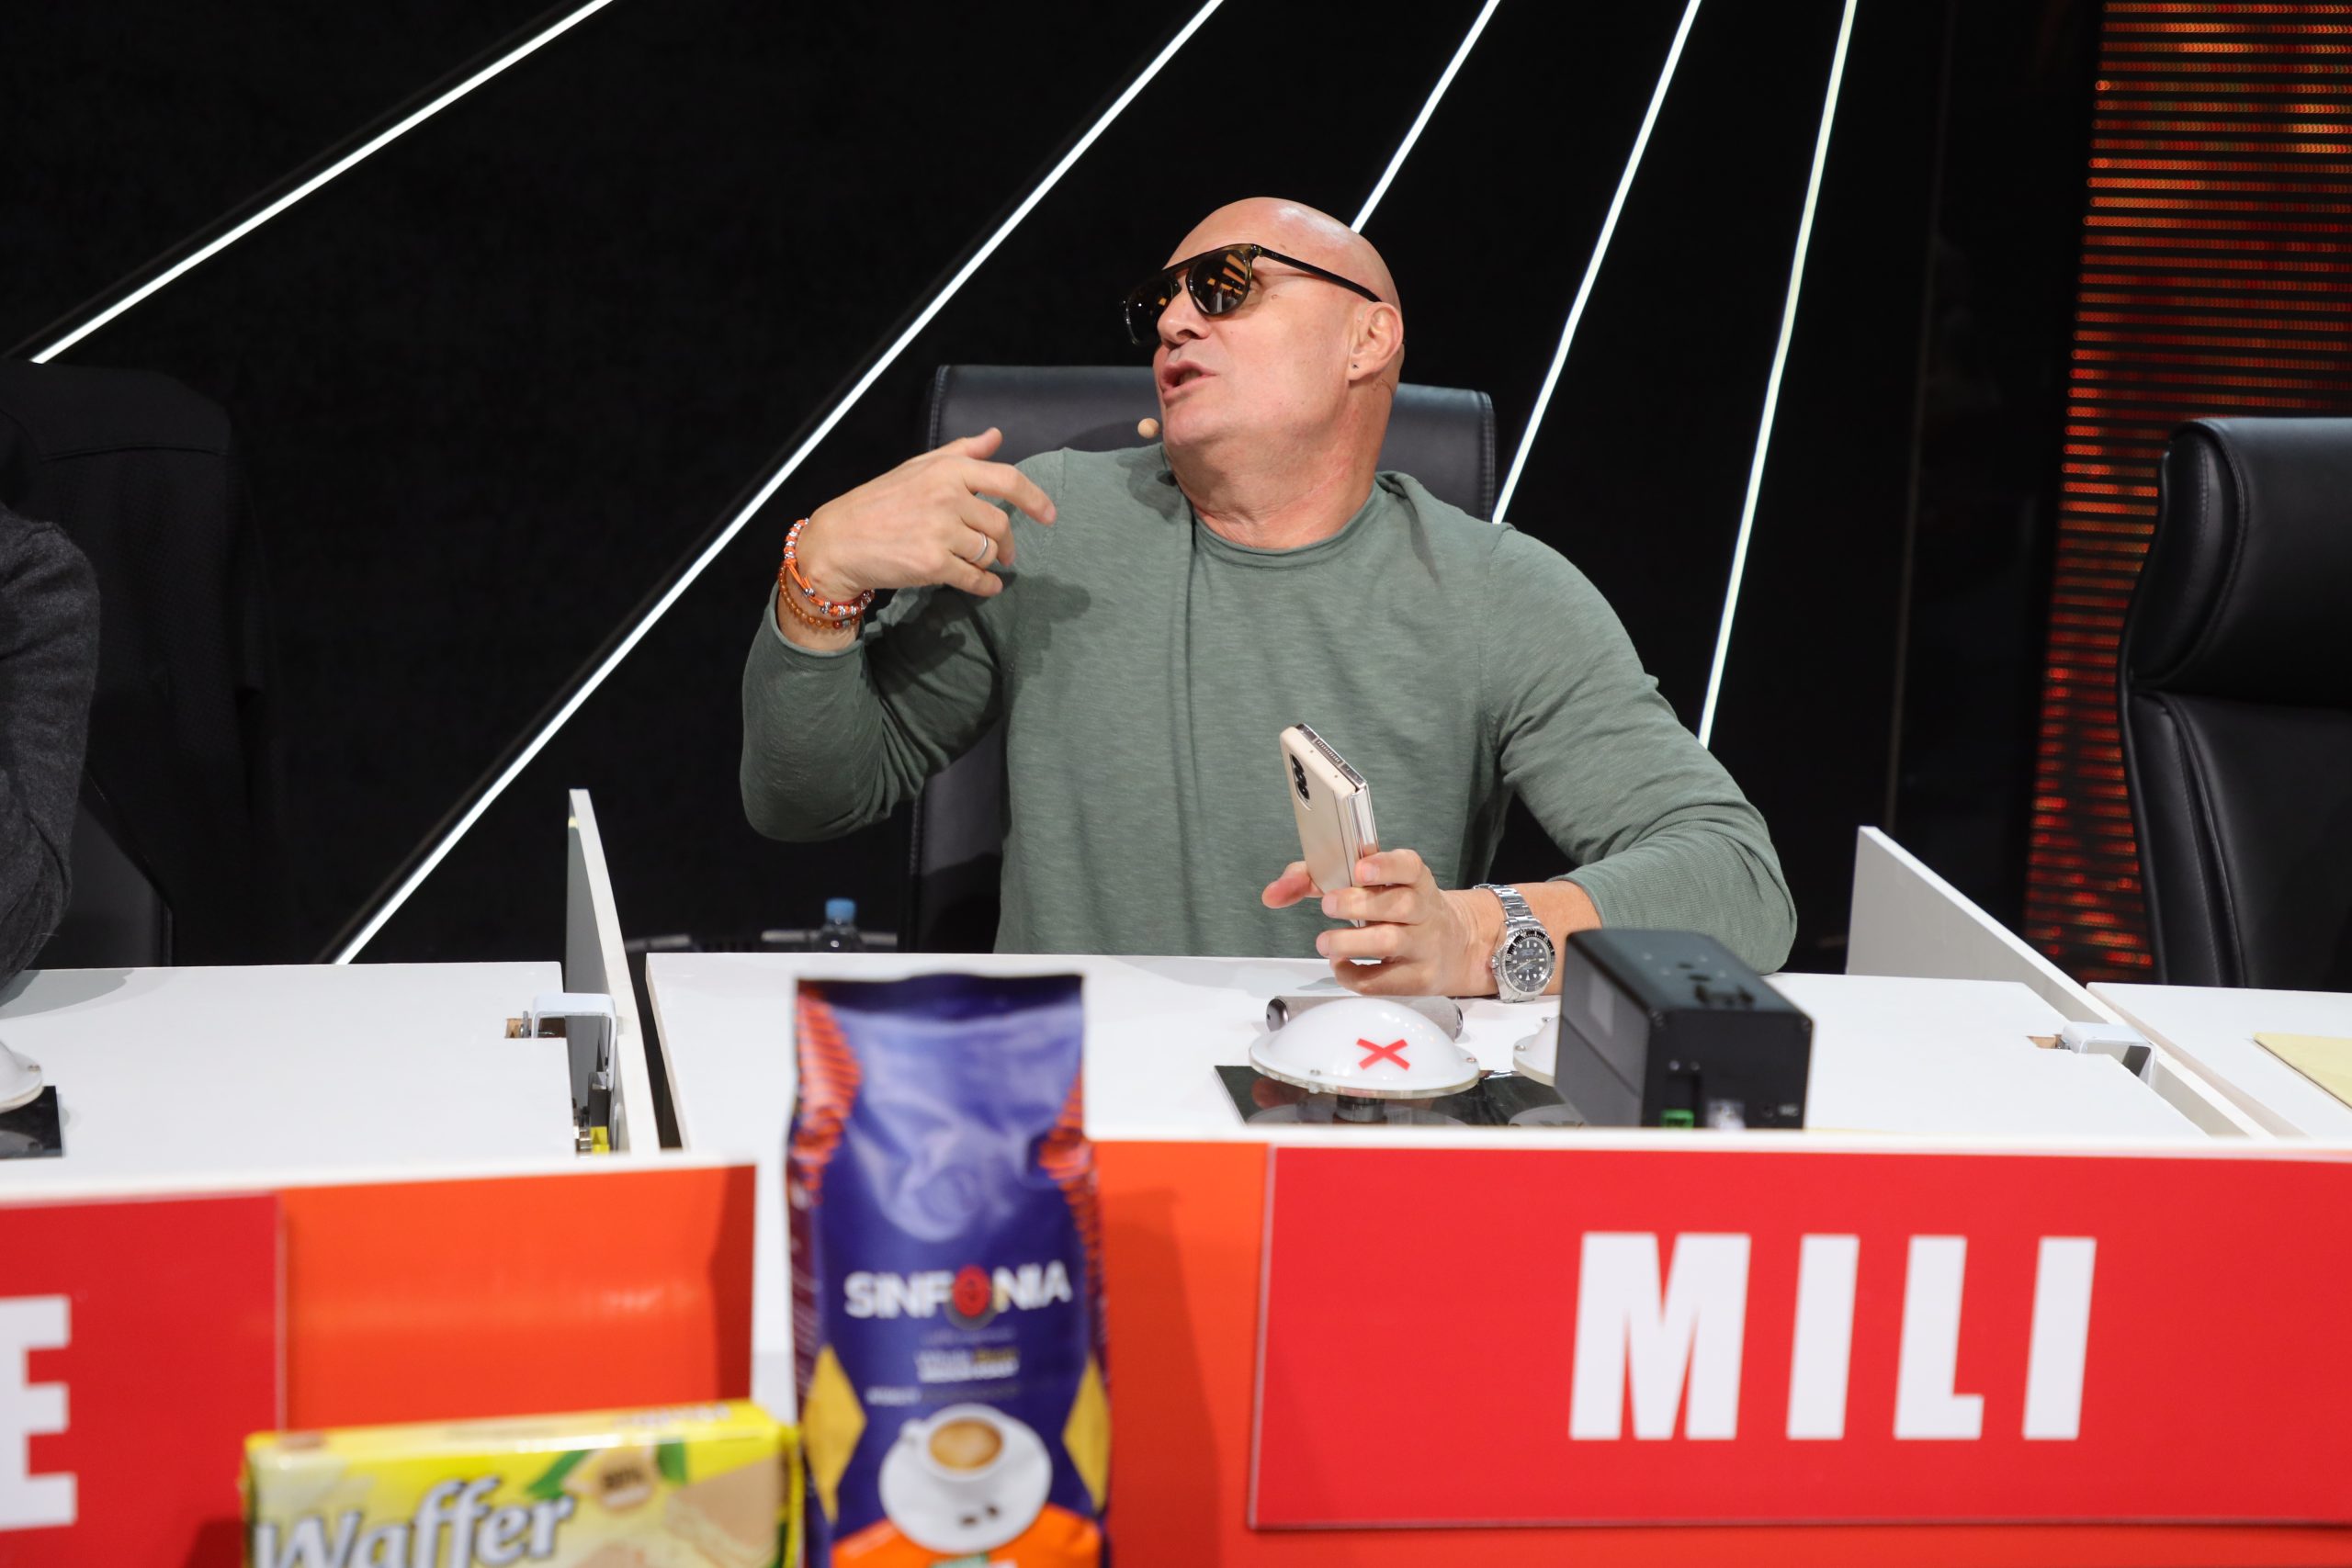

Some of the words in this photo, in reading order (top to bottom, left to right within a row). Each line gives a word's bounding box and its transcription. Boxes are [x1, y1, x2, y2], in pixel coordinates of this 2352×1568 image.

[843, 1259, 1073, 1319] SINFONIA
[1569, 1231, 2098, 1441] MILI
[254, 1474, 575, 1568] Waffer
